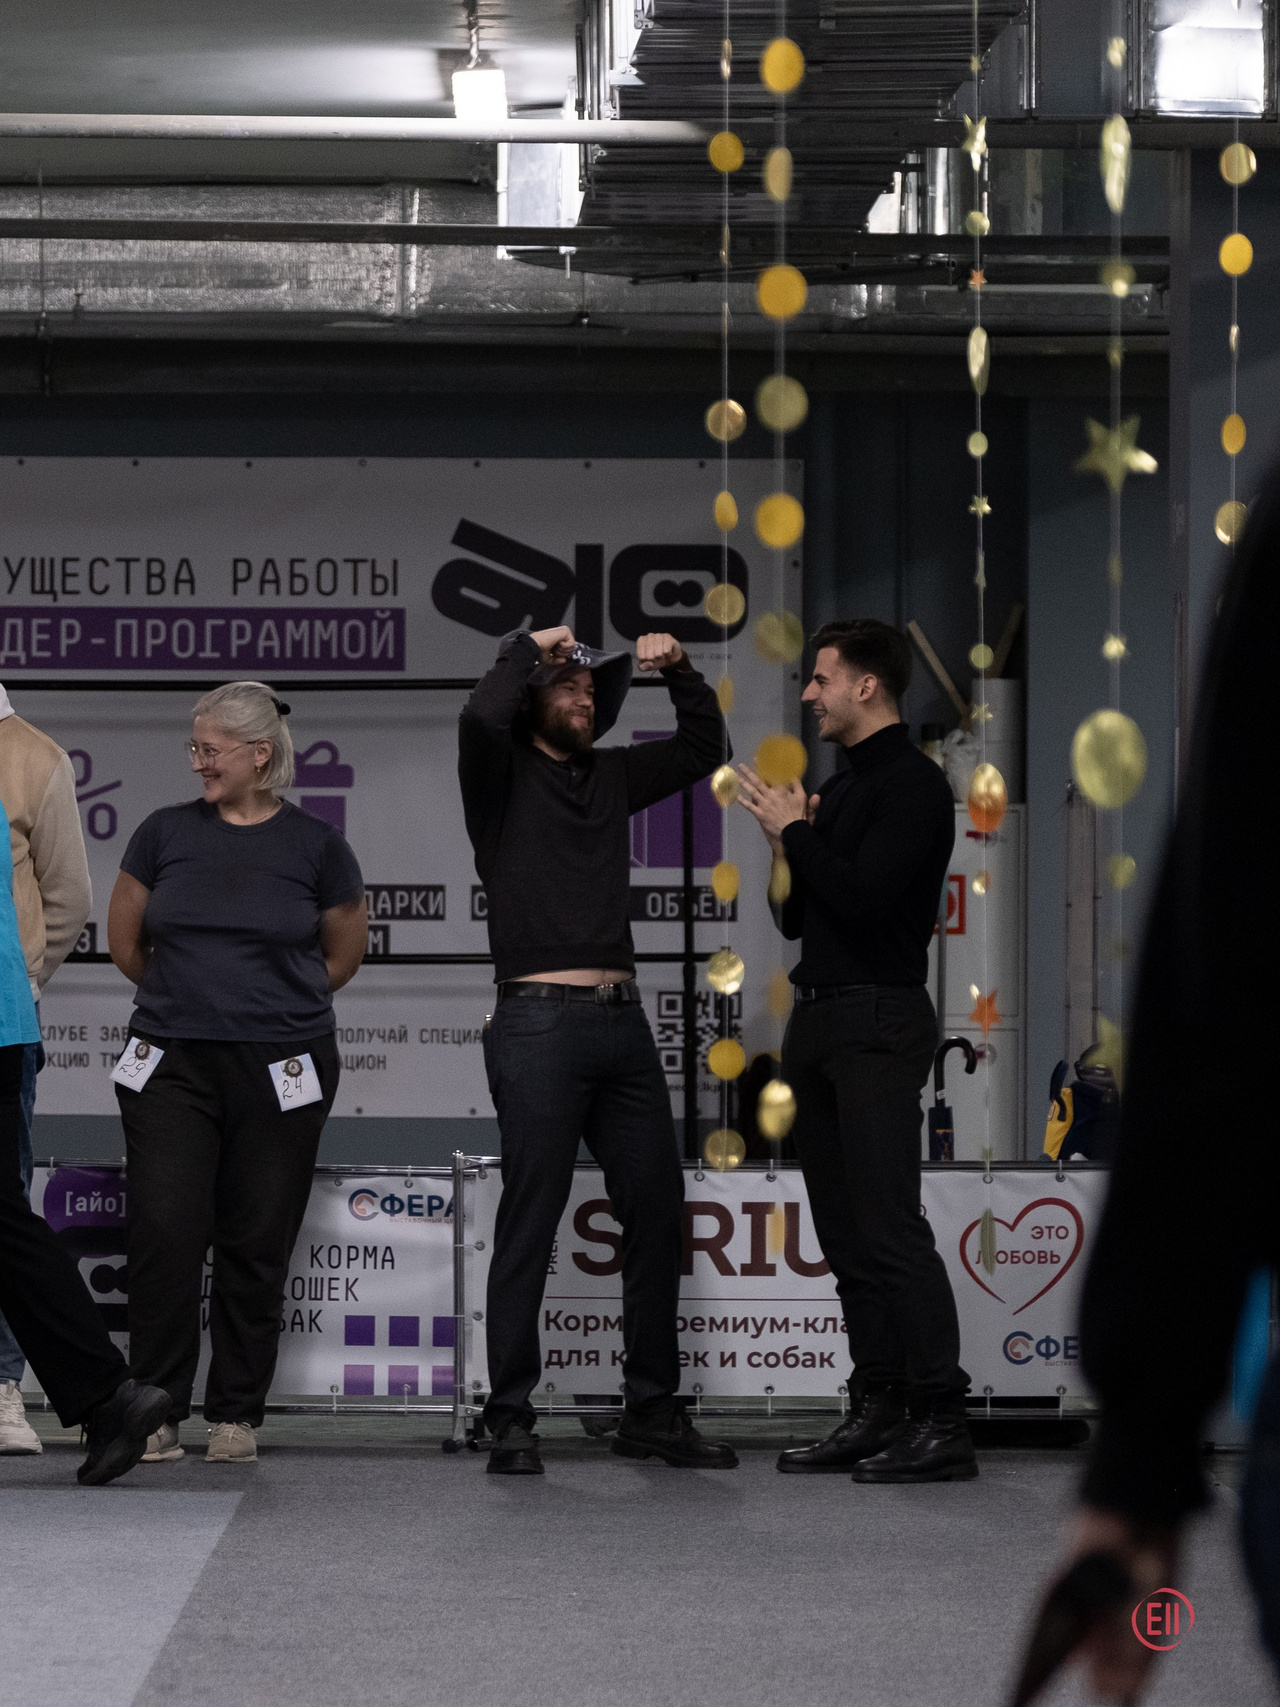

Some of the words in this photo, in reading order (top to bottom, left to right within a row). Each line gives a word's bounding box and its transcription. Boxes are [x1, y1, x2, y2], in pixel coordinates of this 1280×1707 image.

[231, 557, 400, 597] РАБОТЫ
[335, 1024, 409, 1044] ПОЛУЧАЙ
[420, 1027, 483, 1046] СПЕЦИА
[118, 1056, 148, 1078] 29
[282, 1077, 303, 1100] 24
[571, 1198, 834, 1278] SRIU
[1031, 1225, 1069, 1240] ЭТО
[310, 1244, 395, 1270] КОРМА
[291, 1276, 359, 1302] ОШЕК
[544, 1310, 624, 1337] Корм
[544, 1349, 601, 1369] для
[611, 1350, 710, 1368] кек
[719, 1350, 737, 1368] и
[747, 1345, 837, 1369] собак
[1002, 1330, 1079, 1365] СФЕ
